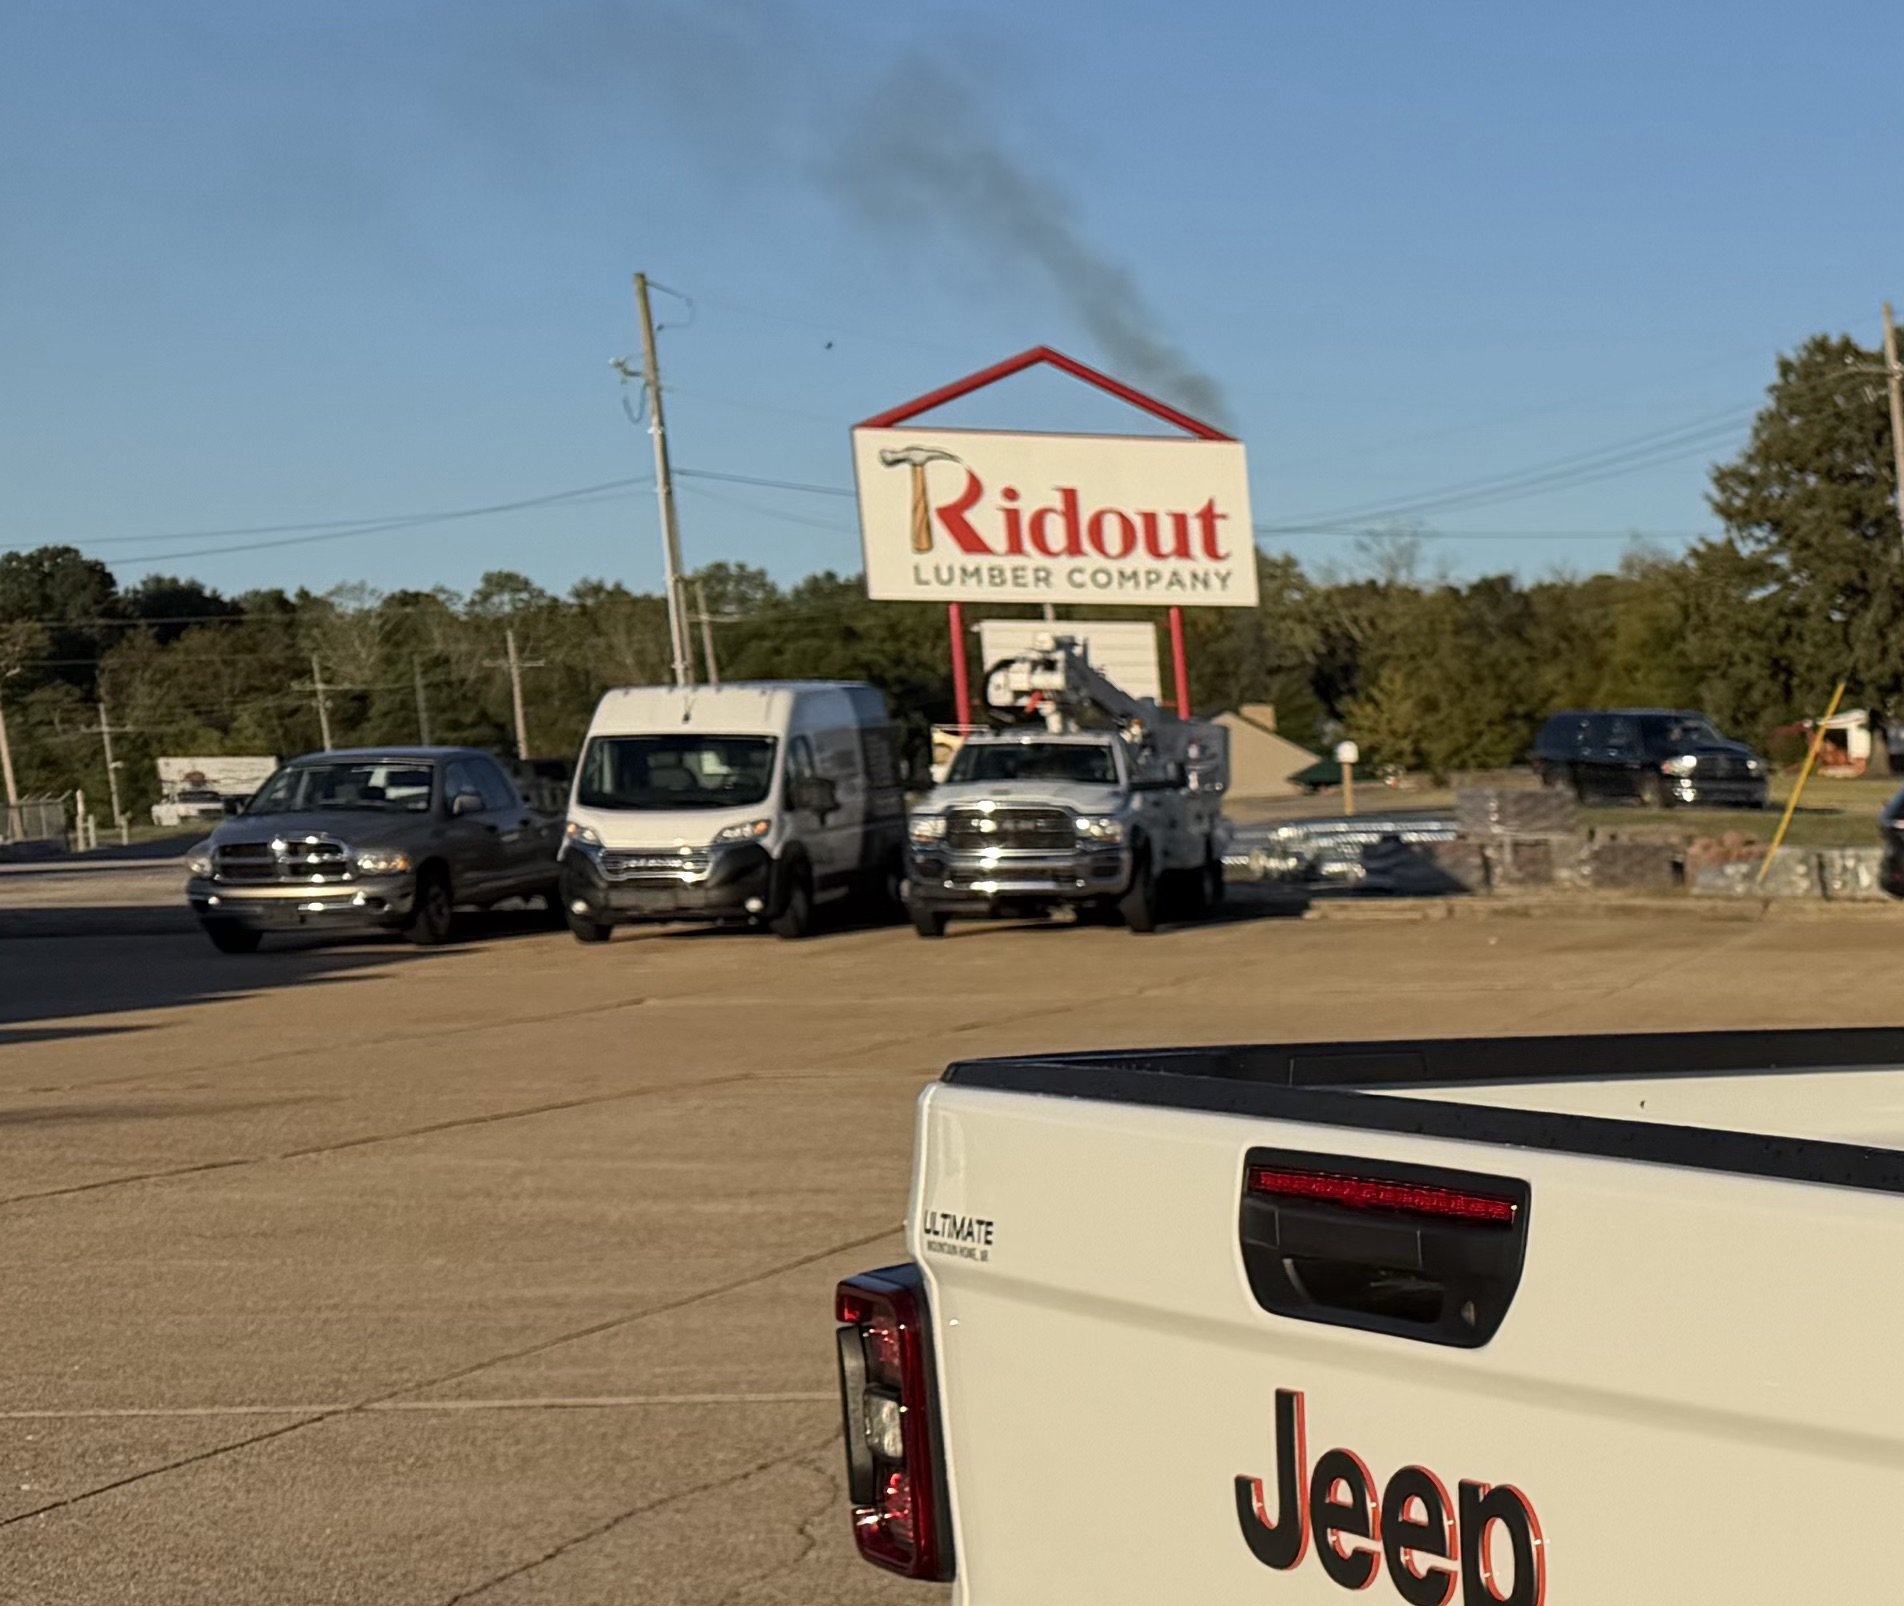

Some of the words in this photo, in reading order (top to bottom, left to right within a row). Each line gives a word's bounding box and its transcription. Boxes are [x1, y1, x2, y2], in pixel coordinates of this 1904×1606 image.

[878, 446, 1230, 560] Ridout
[913, 564, 1052, 589] LUMBER
[1066, 567, 1233, 592] COMPANY
[923, 1210, 994, 1246] ULTIMATE
